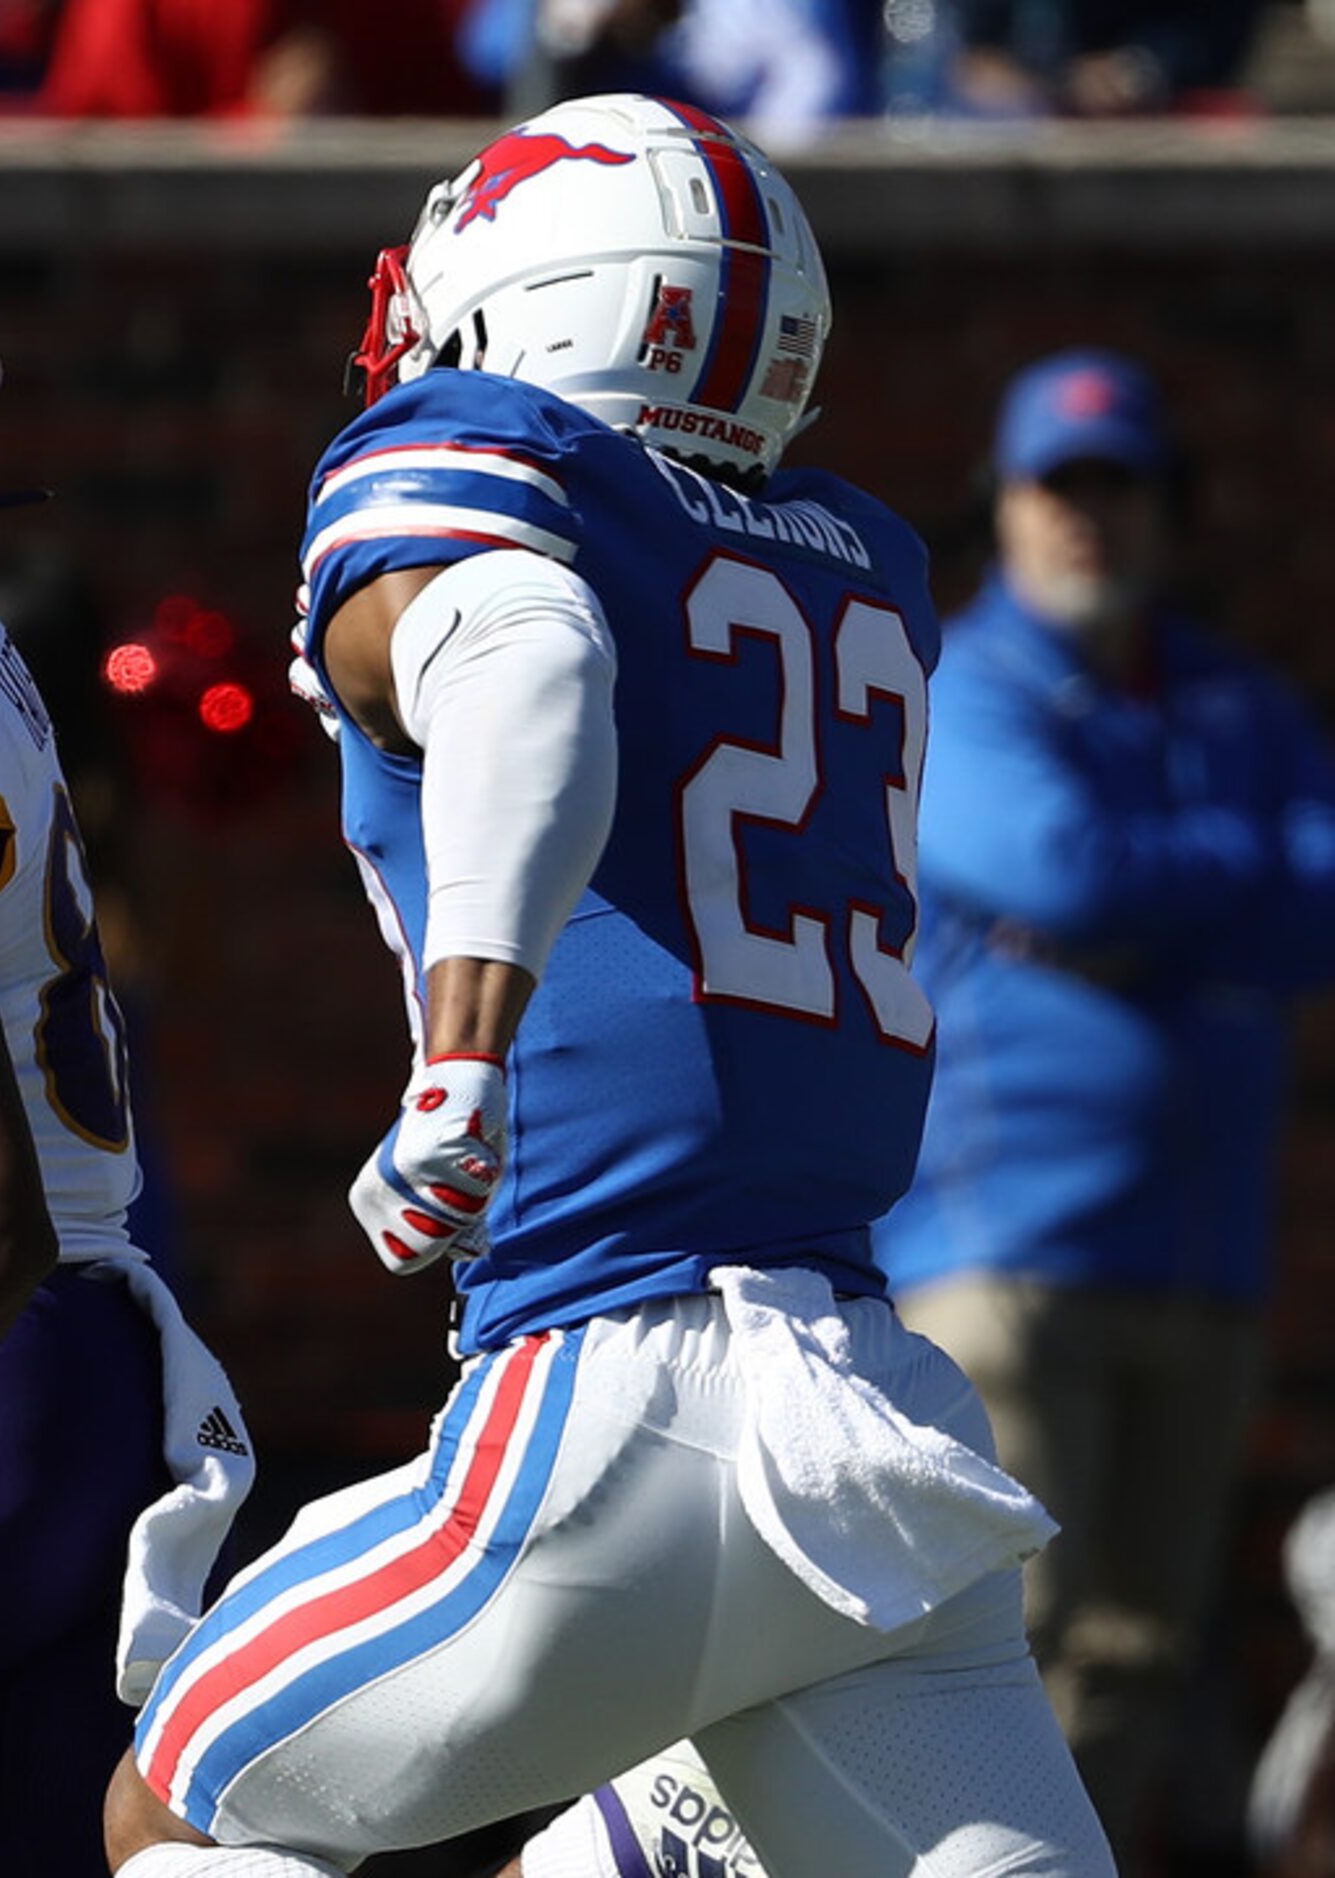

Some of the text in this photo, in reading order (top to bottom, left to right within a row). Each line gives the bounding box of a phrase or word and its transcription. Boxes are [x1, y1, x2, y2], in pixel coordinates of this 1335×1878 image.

[647, 349, 684, 375] P6
[635, 403, 767, 457] MUSTANGS
[675, 547, 937, 1058] 23
